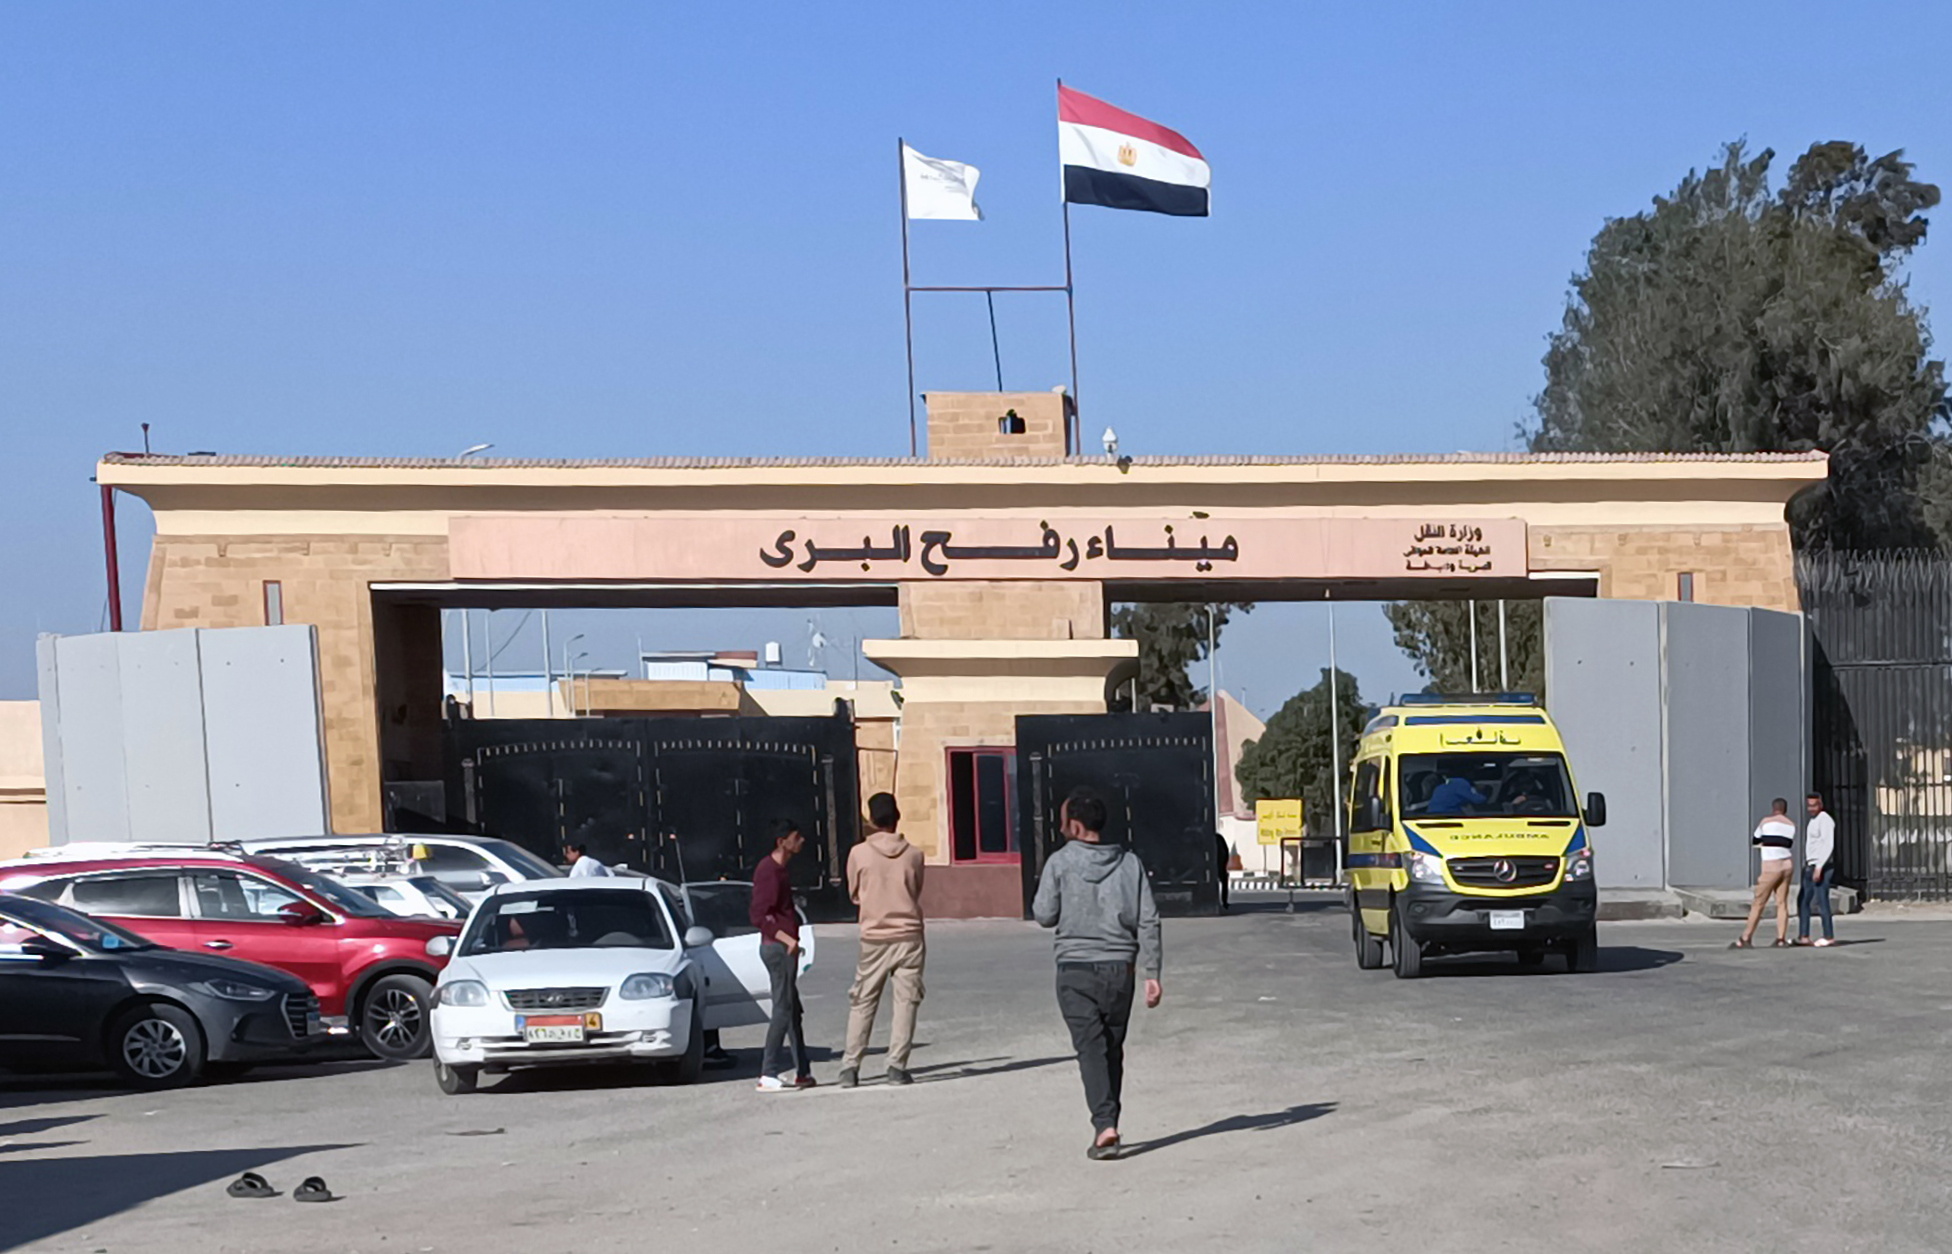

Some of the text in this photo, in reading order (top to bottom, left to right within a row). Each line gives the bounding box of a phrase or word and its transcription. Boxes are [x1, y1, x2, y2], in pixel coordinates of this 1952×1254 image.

[921, 519, 1080, 576] رفح
[1086, 524, 1239, 573] ميناء
[1414, 523, 1483, 542] وزارة النقل
